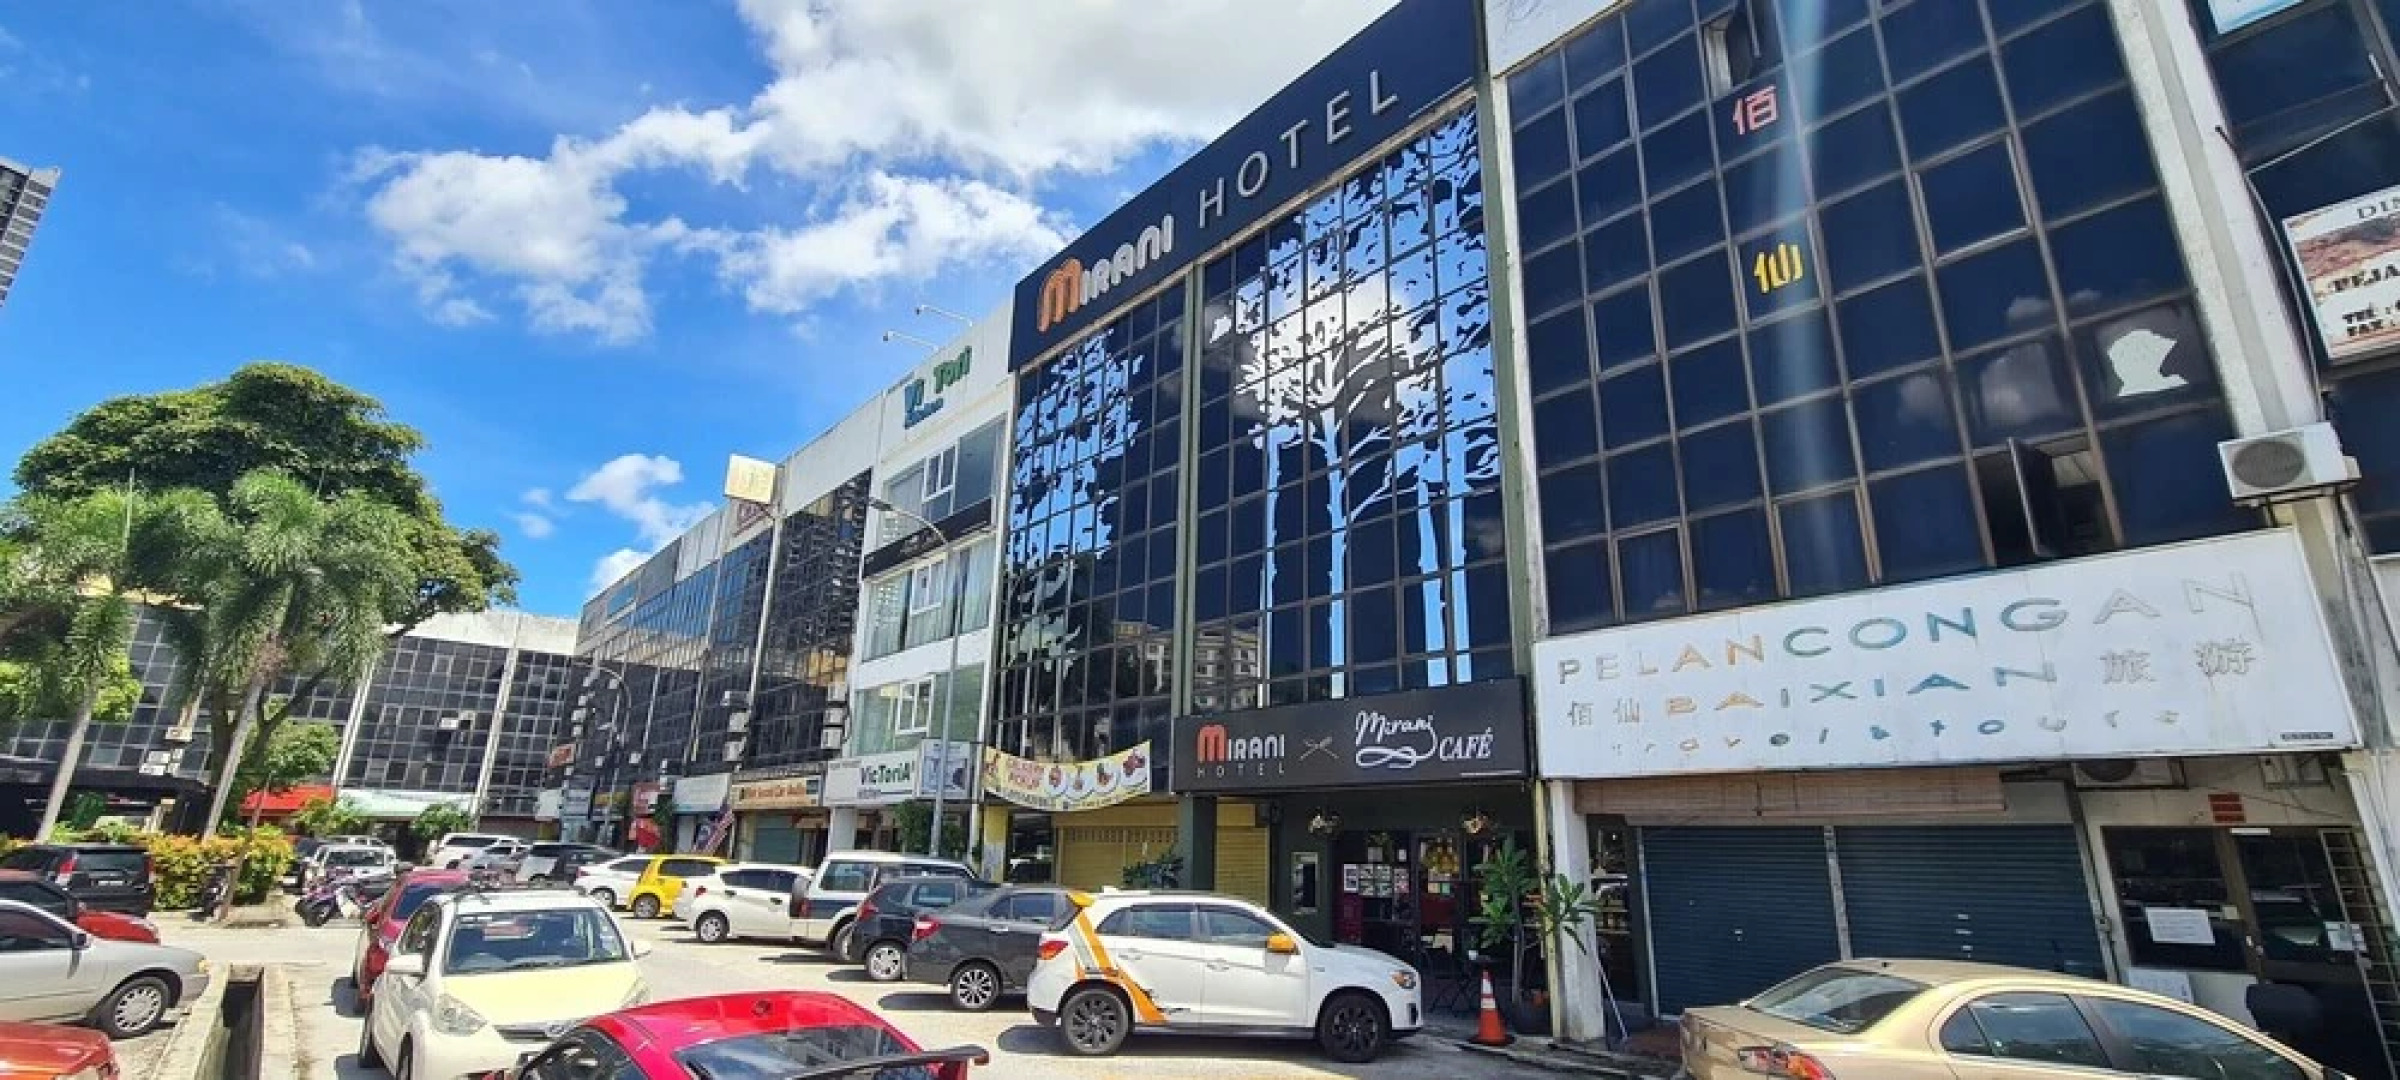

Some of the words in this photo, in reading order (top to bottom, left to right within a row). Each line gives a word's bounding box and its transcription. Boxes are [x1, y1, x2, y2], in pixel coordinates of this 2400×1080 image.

[1037, 214, 1175, 333] MIRANI
[1199, 69, 1398, 229] HOTEL
[1557, 572, 2255, 685] PELANCONGAN
[1667, 663, 2057, 713] BAIXIAN
[1196, 724, 1285, 763] MIRANI
[1355, 710, 1436, 767] Mirani
[1439, 727, 1494, 761] CAFÉ
[1197, 761, 1285, 778] HOTEL
